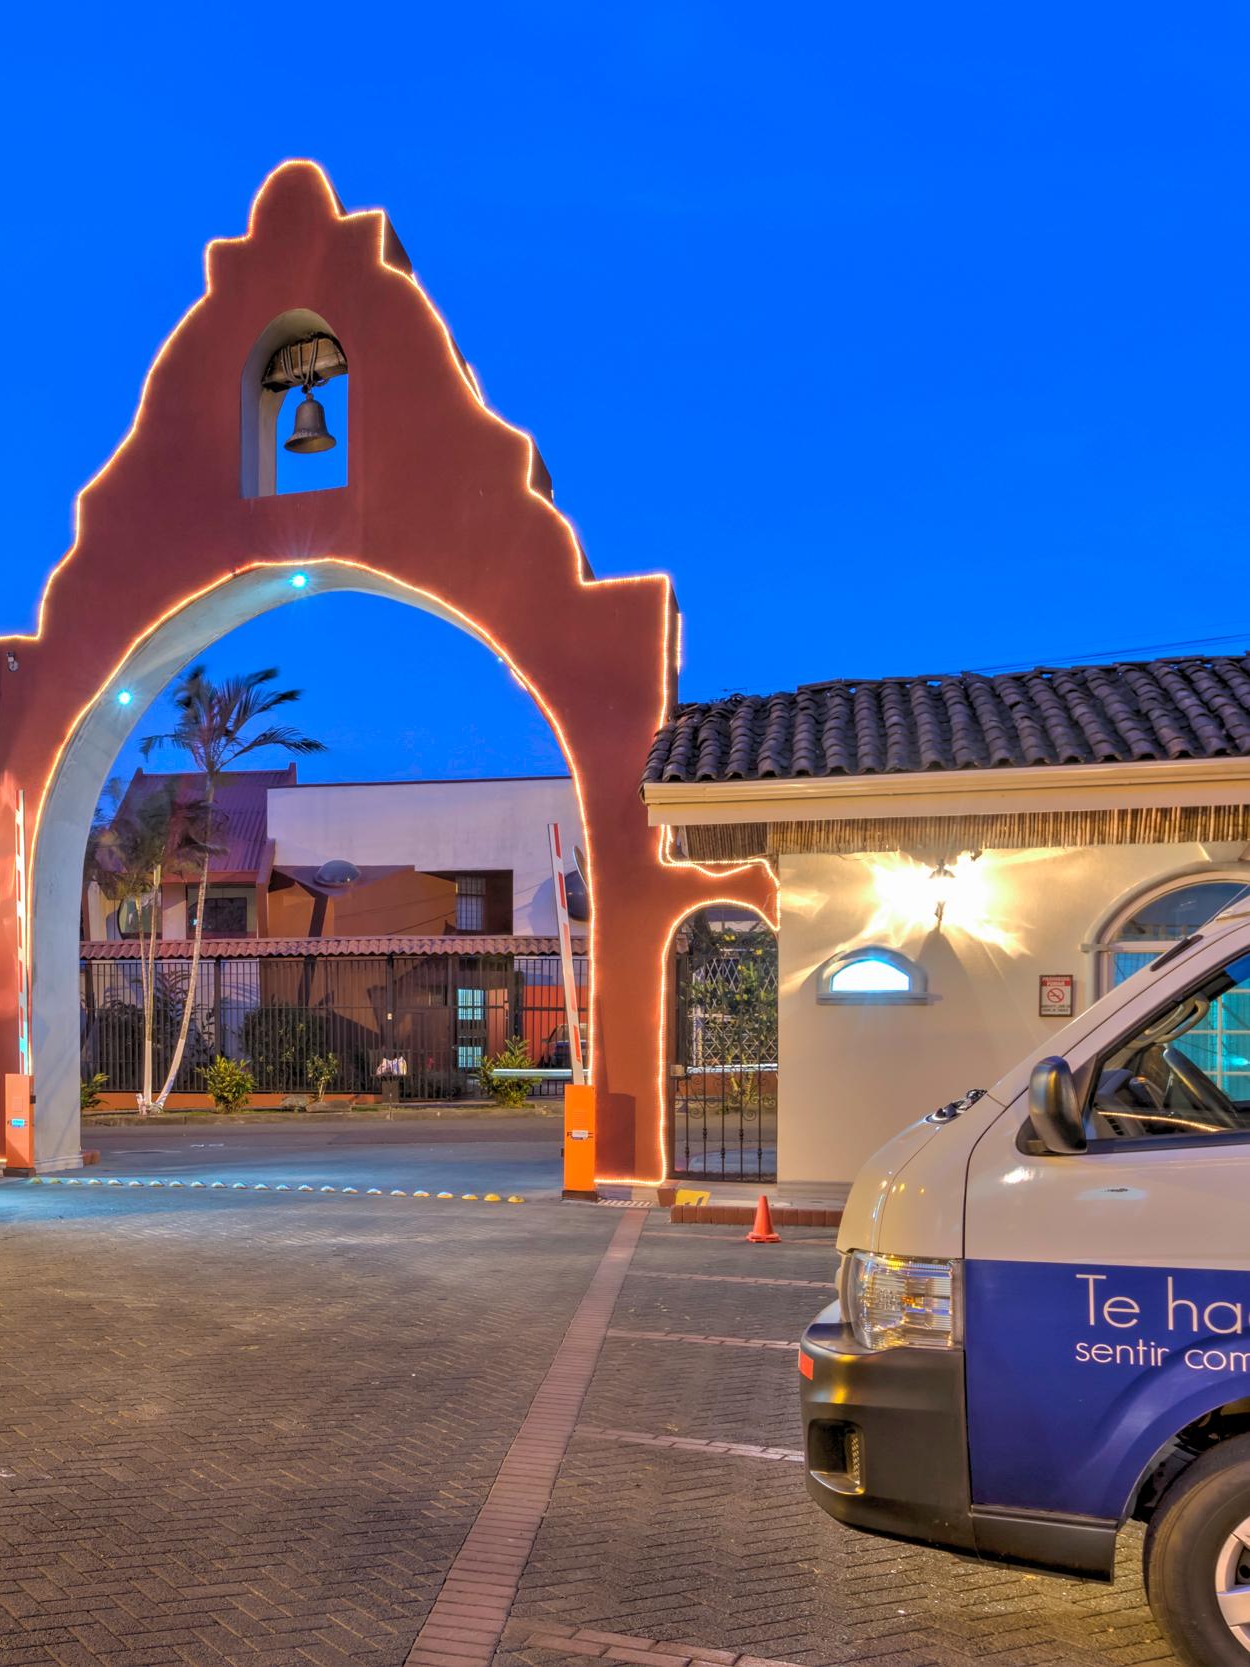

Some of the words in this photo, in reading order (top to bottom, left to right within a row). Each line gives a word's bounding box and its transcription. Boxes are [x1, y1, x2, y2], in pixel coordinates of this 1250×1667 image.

[1075, 1274, 1140, 1328] Te
[1167, 1276, 1250, 1334] ha
[1075, 1338, 1170, 1367] sentir
